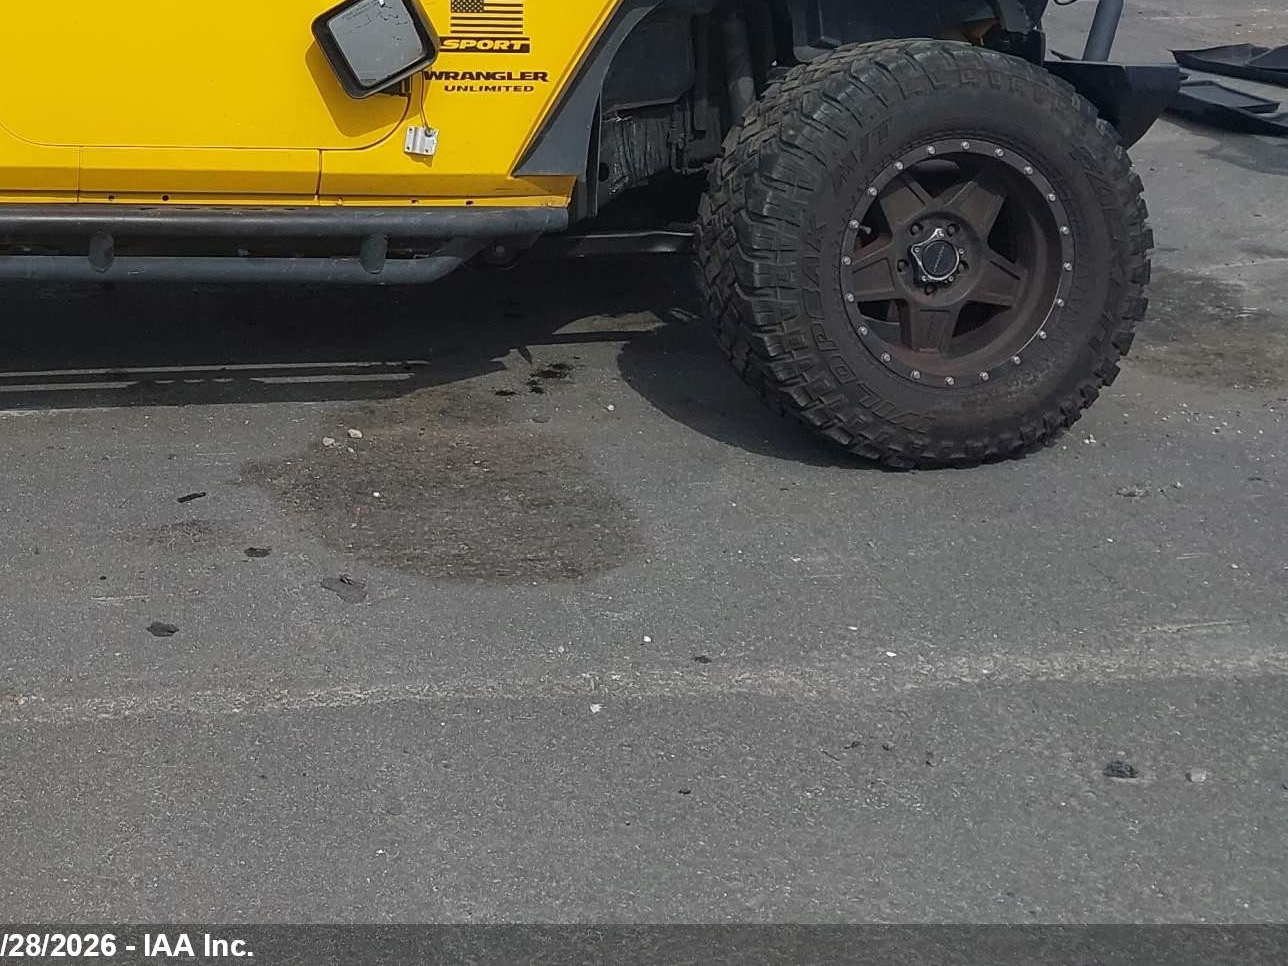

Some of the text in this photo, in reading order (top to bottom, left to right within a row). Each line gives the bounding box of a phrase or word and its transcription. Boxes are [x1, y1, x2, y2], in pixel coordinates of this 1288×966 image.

[441, 39, 526, 51] SPORT
[423, 70, 551, 83] WRANGLER
[443, 85, 535, 93] UNLIMITED
